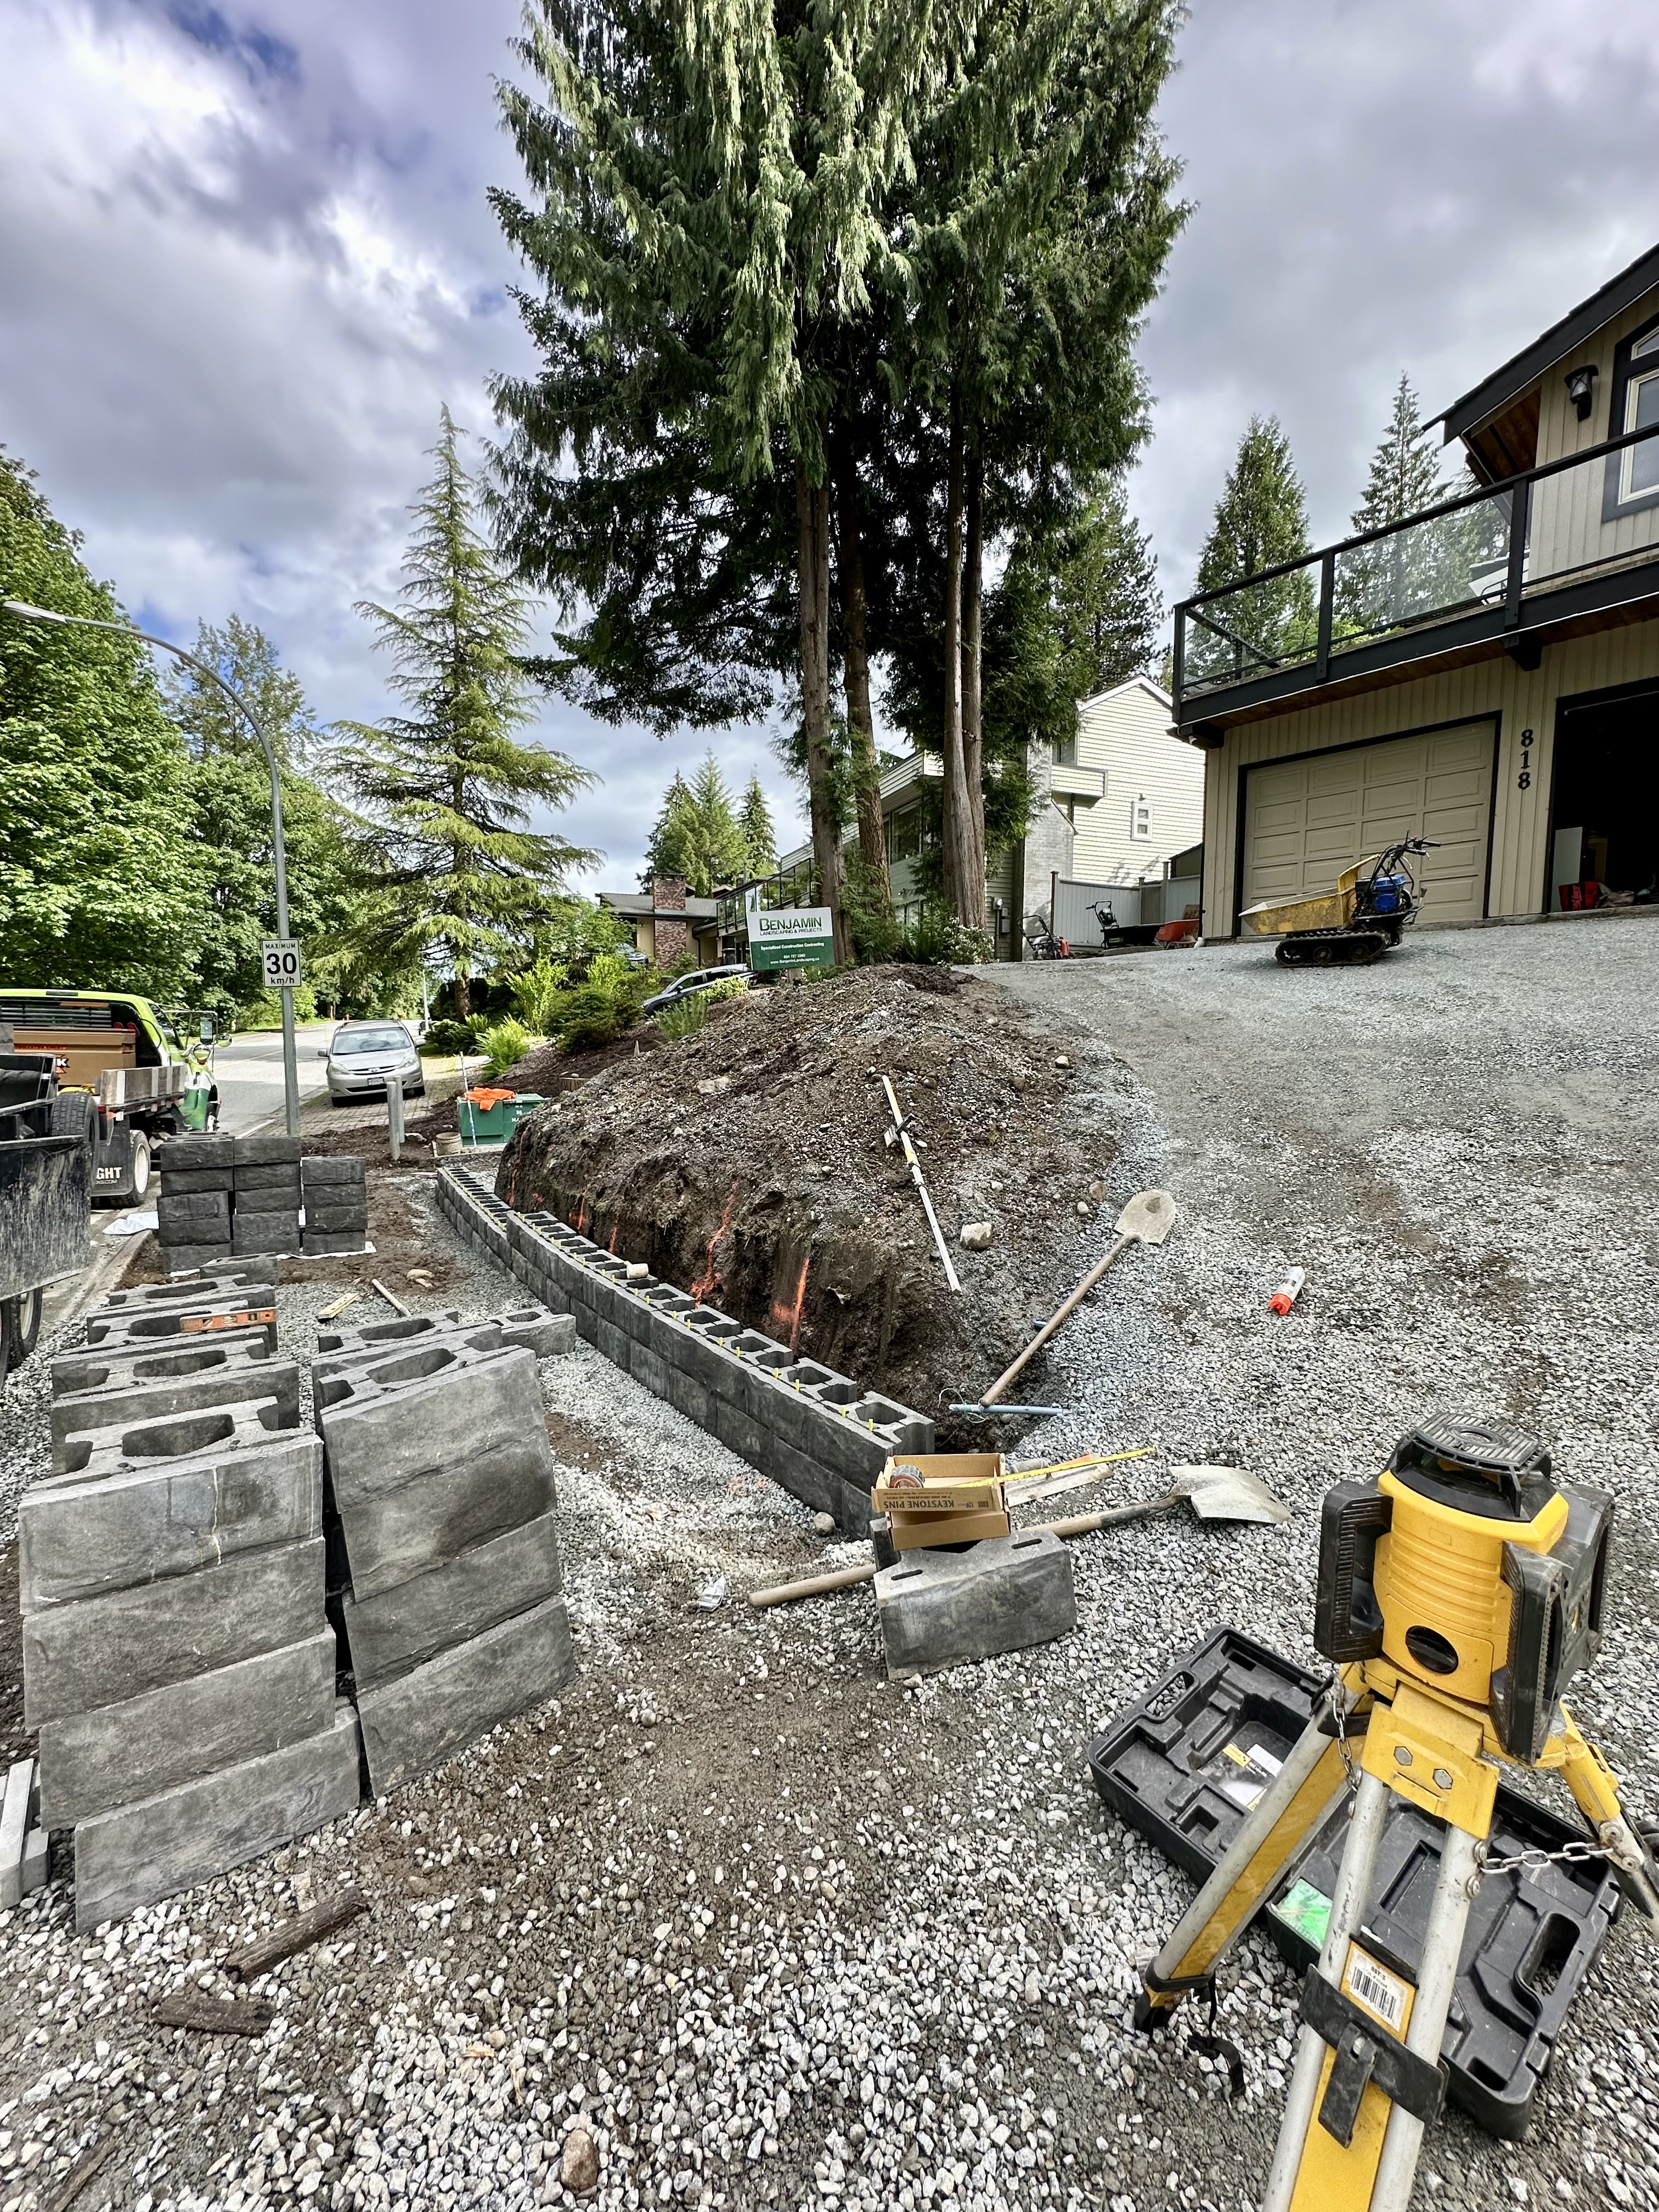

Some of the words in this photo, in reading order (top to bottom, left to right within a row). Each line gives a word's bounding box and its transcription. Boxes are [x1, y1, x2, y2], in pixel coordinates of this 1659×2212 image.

[1517, 729, 1534, 790] 818
[759, 917, 822, 932] BENJAMIN
[266, 952, 297, 975] 30
[97, 1167, 122, 1180] GHT
[883, 1500, 905, 1509] PINS
[907, 1500, 955, 1508] KEYSTONE
